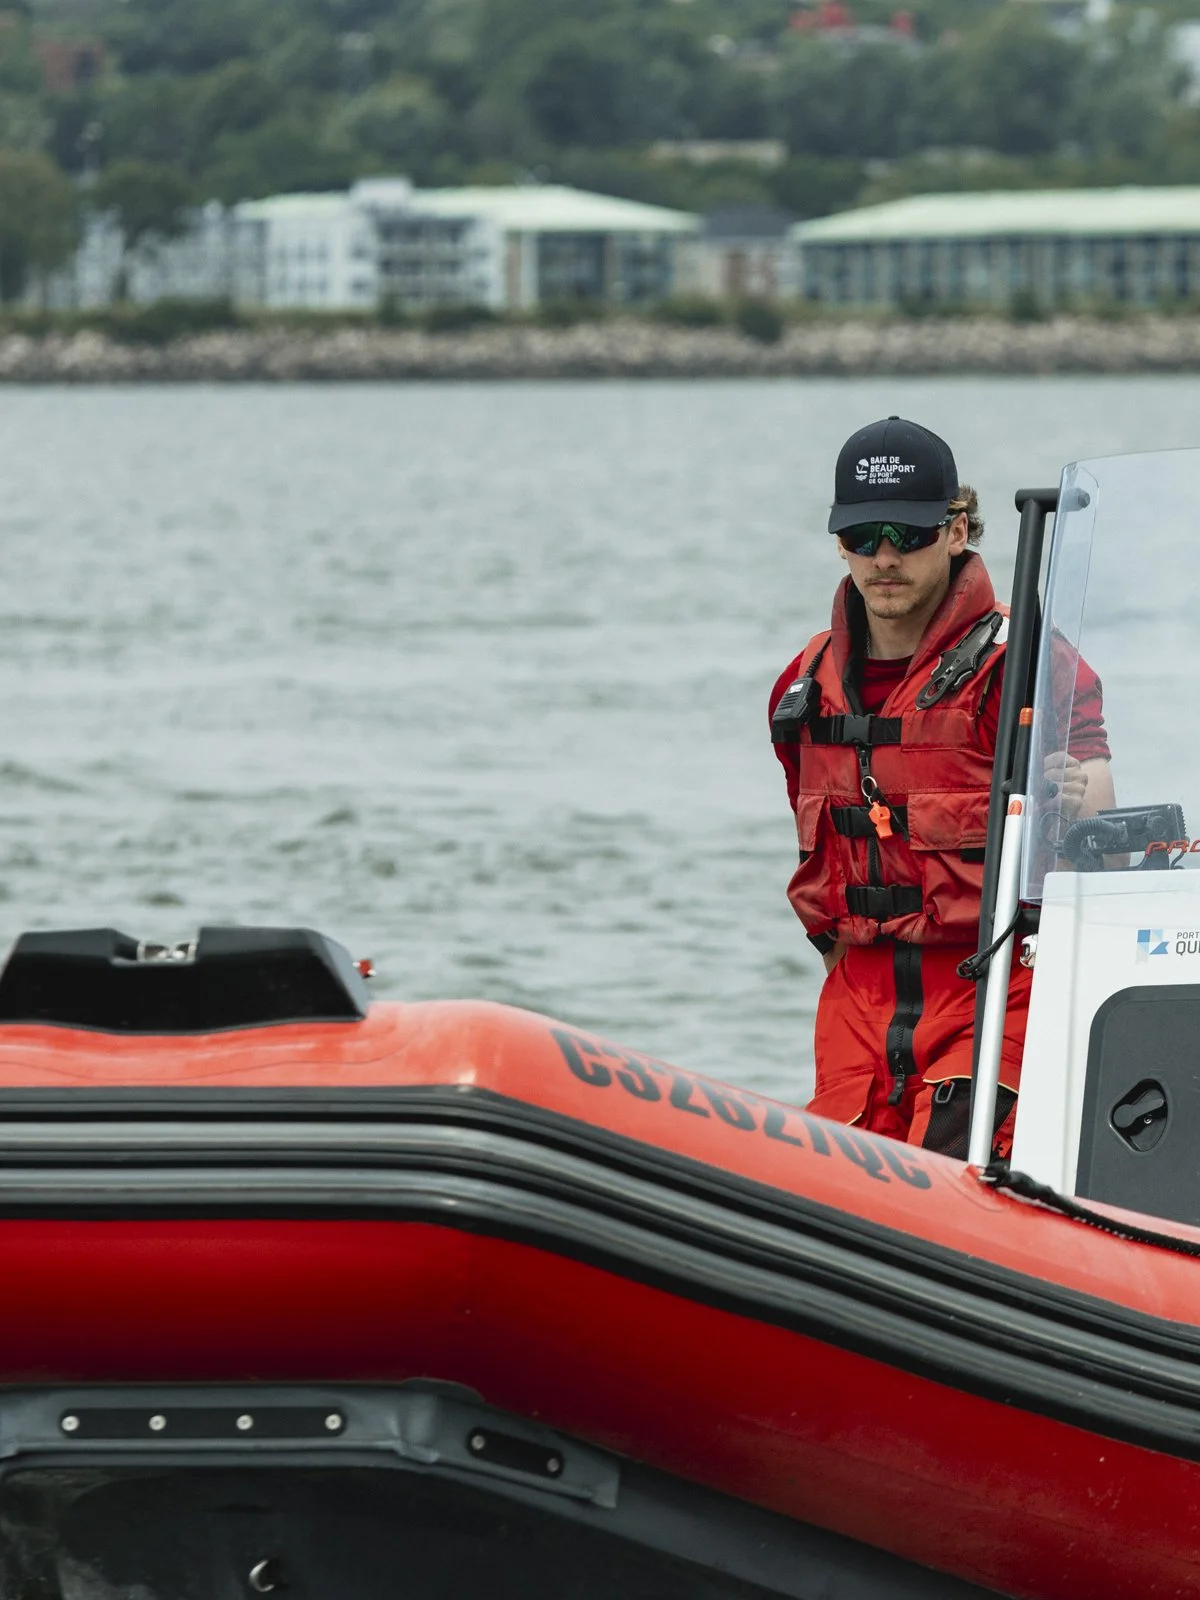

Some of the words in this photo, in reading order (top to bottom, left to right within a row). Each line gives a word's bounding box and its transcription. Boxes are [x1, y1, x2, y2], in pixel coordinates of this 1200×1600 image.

[870, 456, 888, 464] BAIE
[889, 456, 900, 464] DE
[870, 464, 916, 473] BEAUPORT
[1176, 931, 1200, 940] PORT
